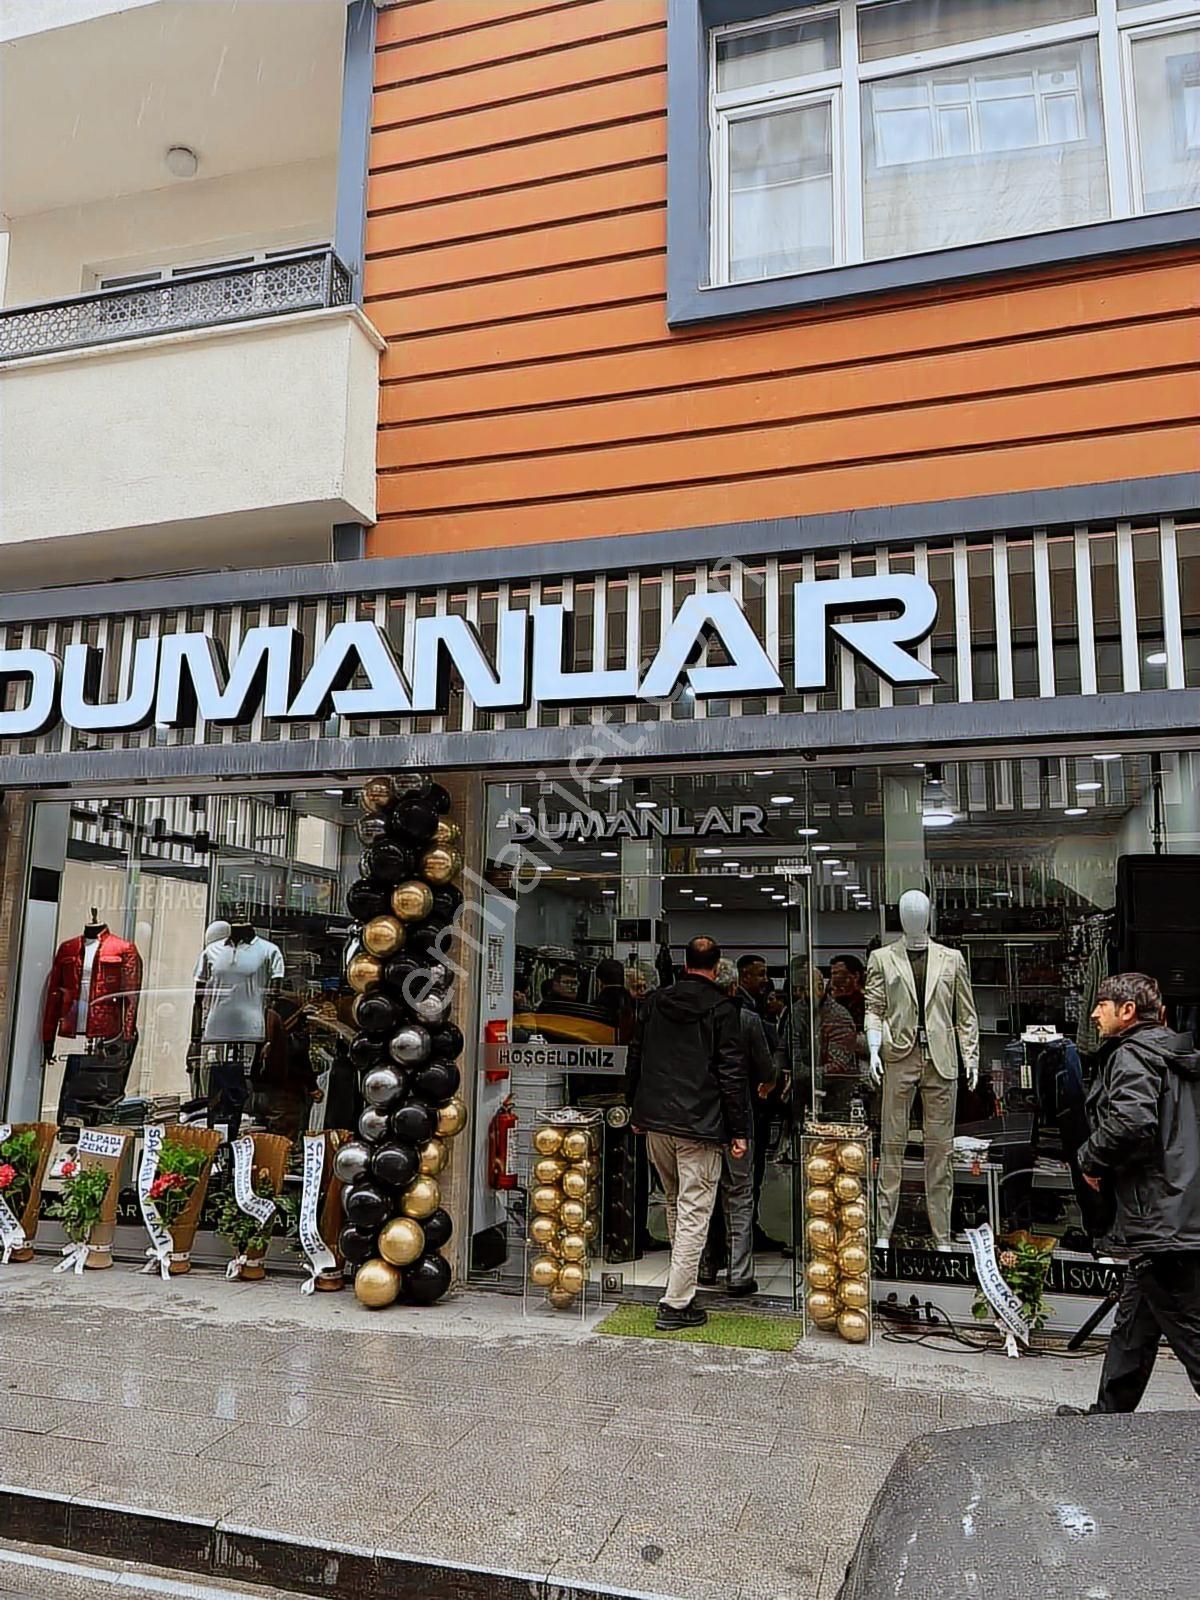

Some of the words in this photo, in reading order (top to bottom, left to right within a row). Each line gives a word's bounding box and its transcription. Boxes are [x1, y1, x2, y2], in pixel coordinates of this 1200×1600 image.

[0, 573, 939, 735] DUMANLAR
[512, 804, 766, 840] DUMANLAR
[499, 1047, 614, 1067] HOŞGELDİNİZ
[304, 1142, 315, 1198] YILMAZ
